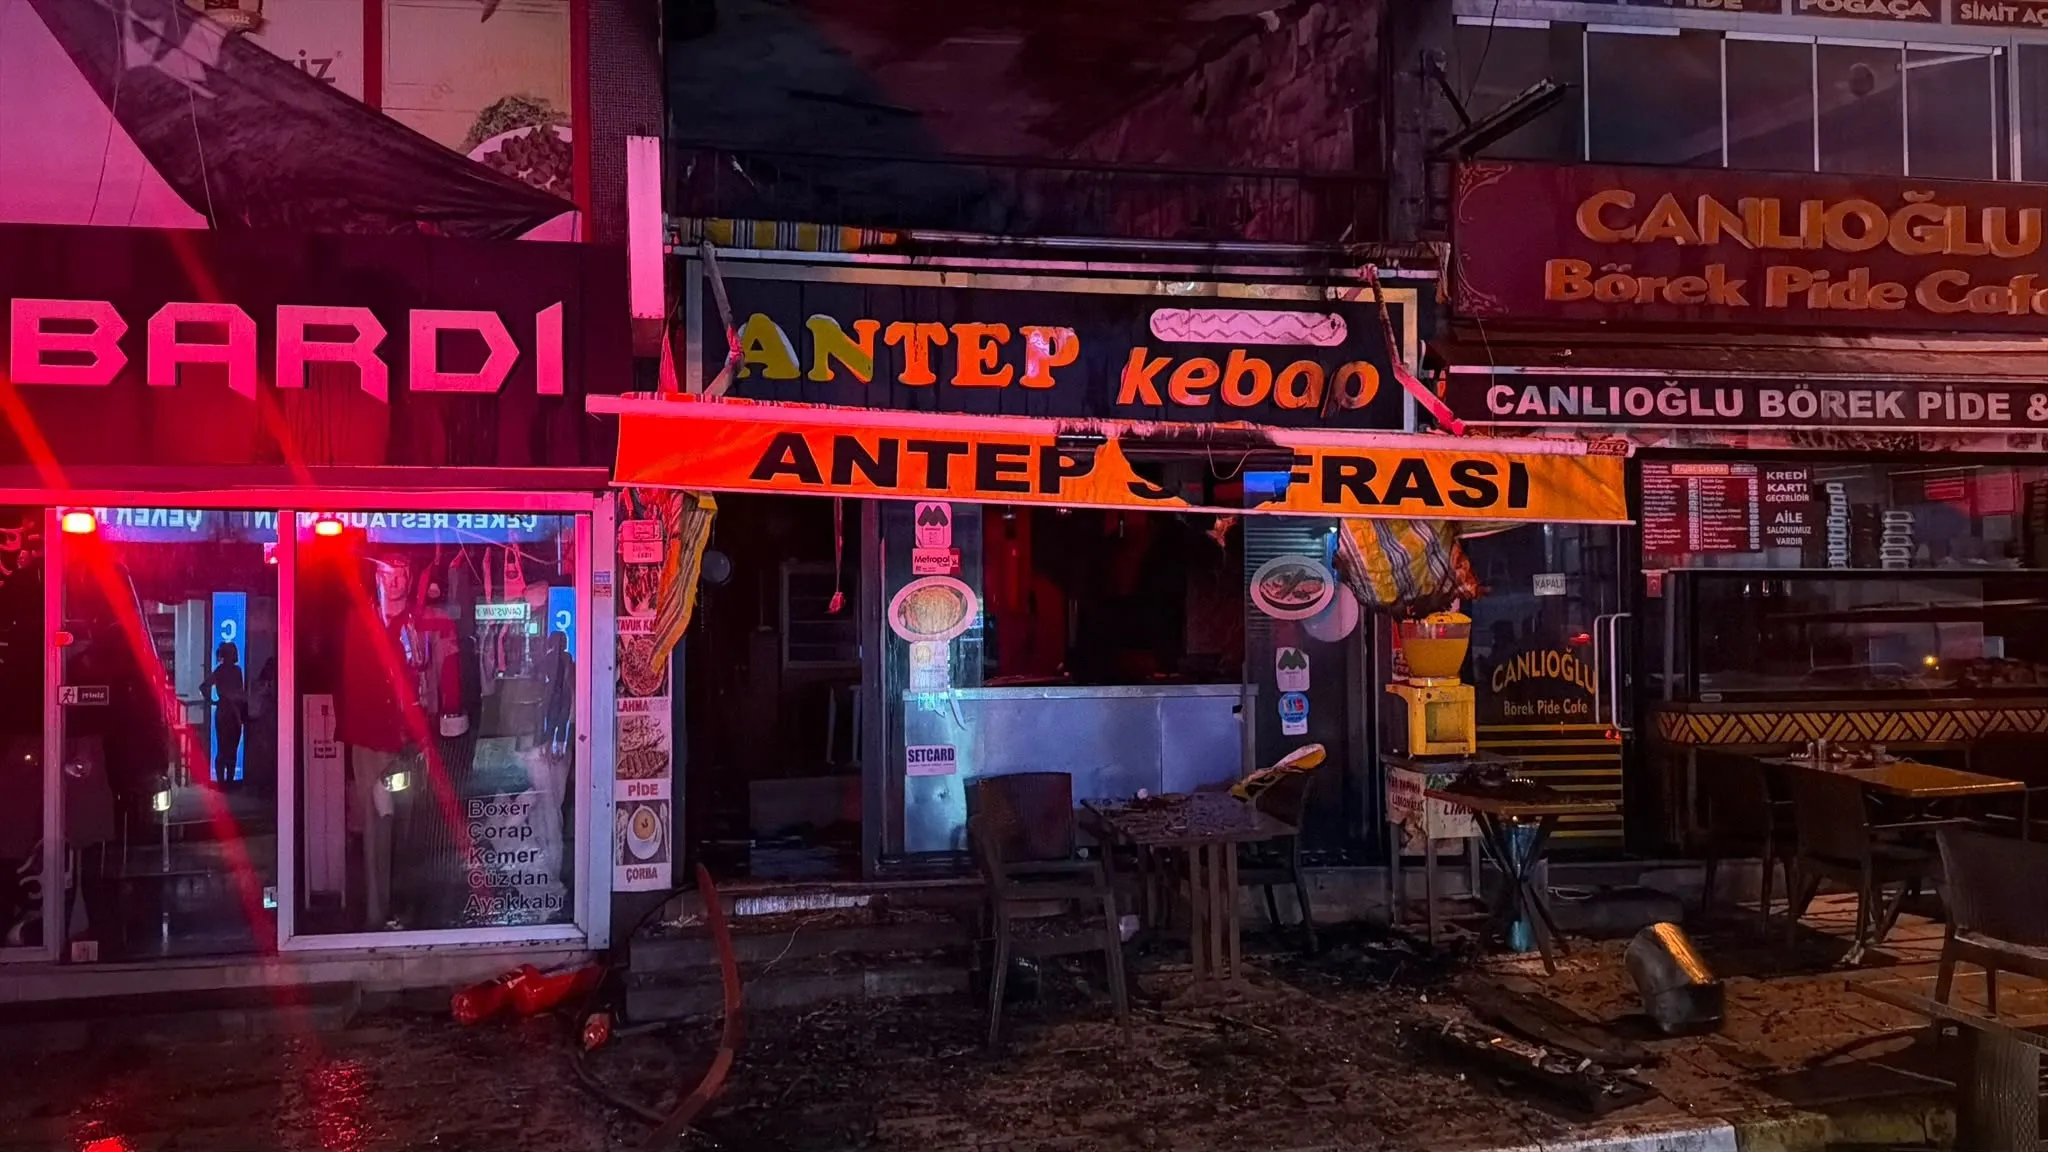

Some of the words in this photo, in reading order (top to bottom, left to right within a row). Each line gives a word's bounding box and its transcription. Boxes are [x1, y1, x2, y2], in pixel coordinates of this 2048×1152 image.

[1960, 1, 2018, 22] SİMİT
[1577, 189, 2043, 259] CANLIOĞLU
[1546, 259, 1749, 307] Börek
[1765, 266, 1907, 310] Pide
[737, 312, 1080, 389] ANTEP
[1116, 346, 1381, 419] kebap
[1487, 381, 1744, 418] CANLIOĞLU
[1759, 382, 1905, 419] BÖREK
[1919, 384, 2010, 421] PİDE
[749, 430, 1097, 494] ANTEP
[1766, 464, 1807, 480] KREDİ
[1767, 484, 1807, 492] KARTI
[1765, 493, 1809, 503] GEÇERLİDİR
[1775, 510, 1803, 523] AİLE
[1766, 526, 1811, 534] SALONUMUZ
[1491, 648, 1596, 694] CANLIOĞLU
[1504, 700, 1534, 716] Börek
[1537, 698, 1560, 714] Pide
[1563, 697, 1588, 714] Cafe
[908, 748, 955, 763] SETCARD
[628, 781, 659, 796] PİDE
[468, 799, 530, 818] Boxer
[468, 823, 533, 843] Çorap
[468, 847, 538, 865] Kemer
[468, 868, 549, 887] Cüzdan
[626, 867, 658, 883] ÇORBA
[464, 893, 563, 914] Ayakkabı
